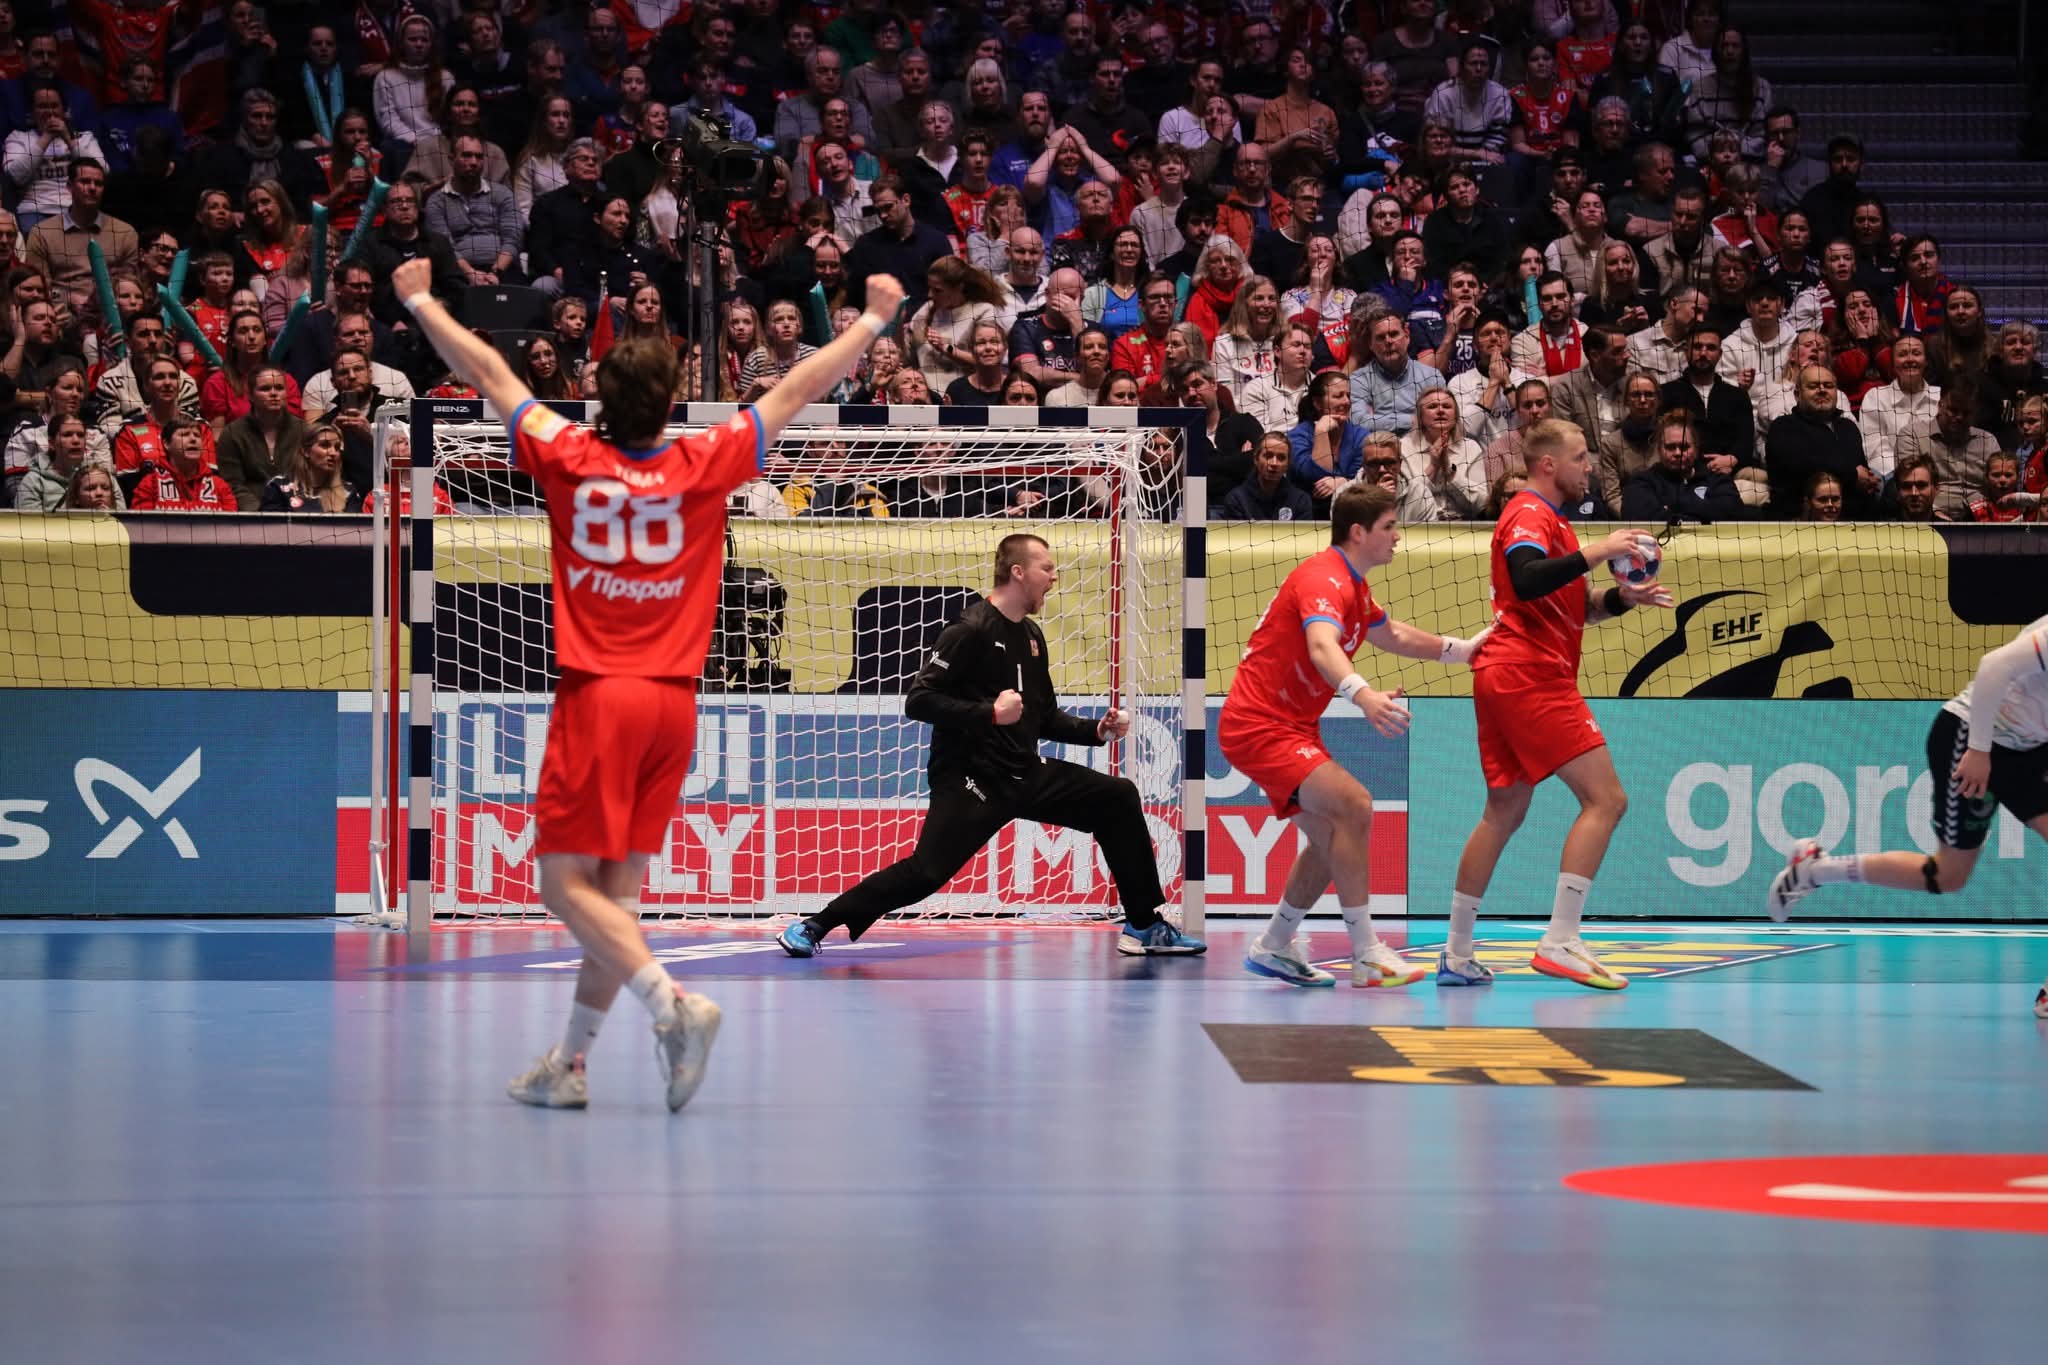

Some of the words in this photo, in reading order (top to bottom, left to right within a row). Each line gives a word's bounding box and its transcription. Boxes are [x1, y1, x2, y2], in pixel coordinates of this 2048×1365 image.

[1455, 340, 1474, 361] 25
[570, 475, 685, 566] 88
[590, 569, 686, 604] Tipsport
[1712, 611, 1763, 642] EHF
[472, 812, 761, 894] MLY
